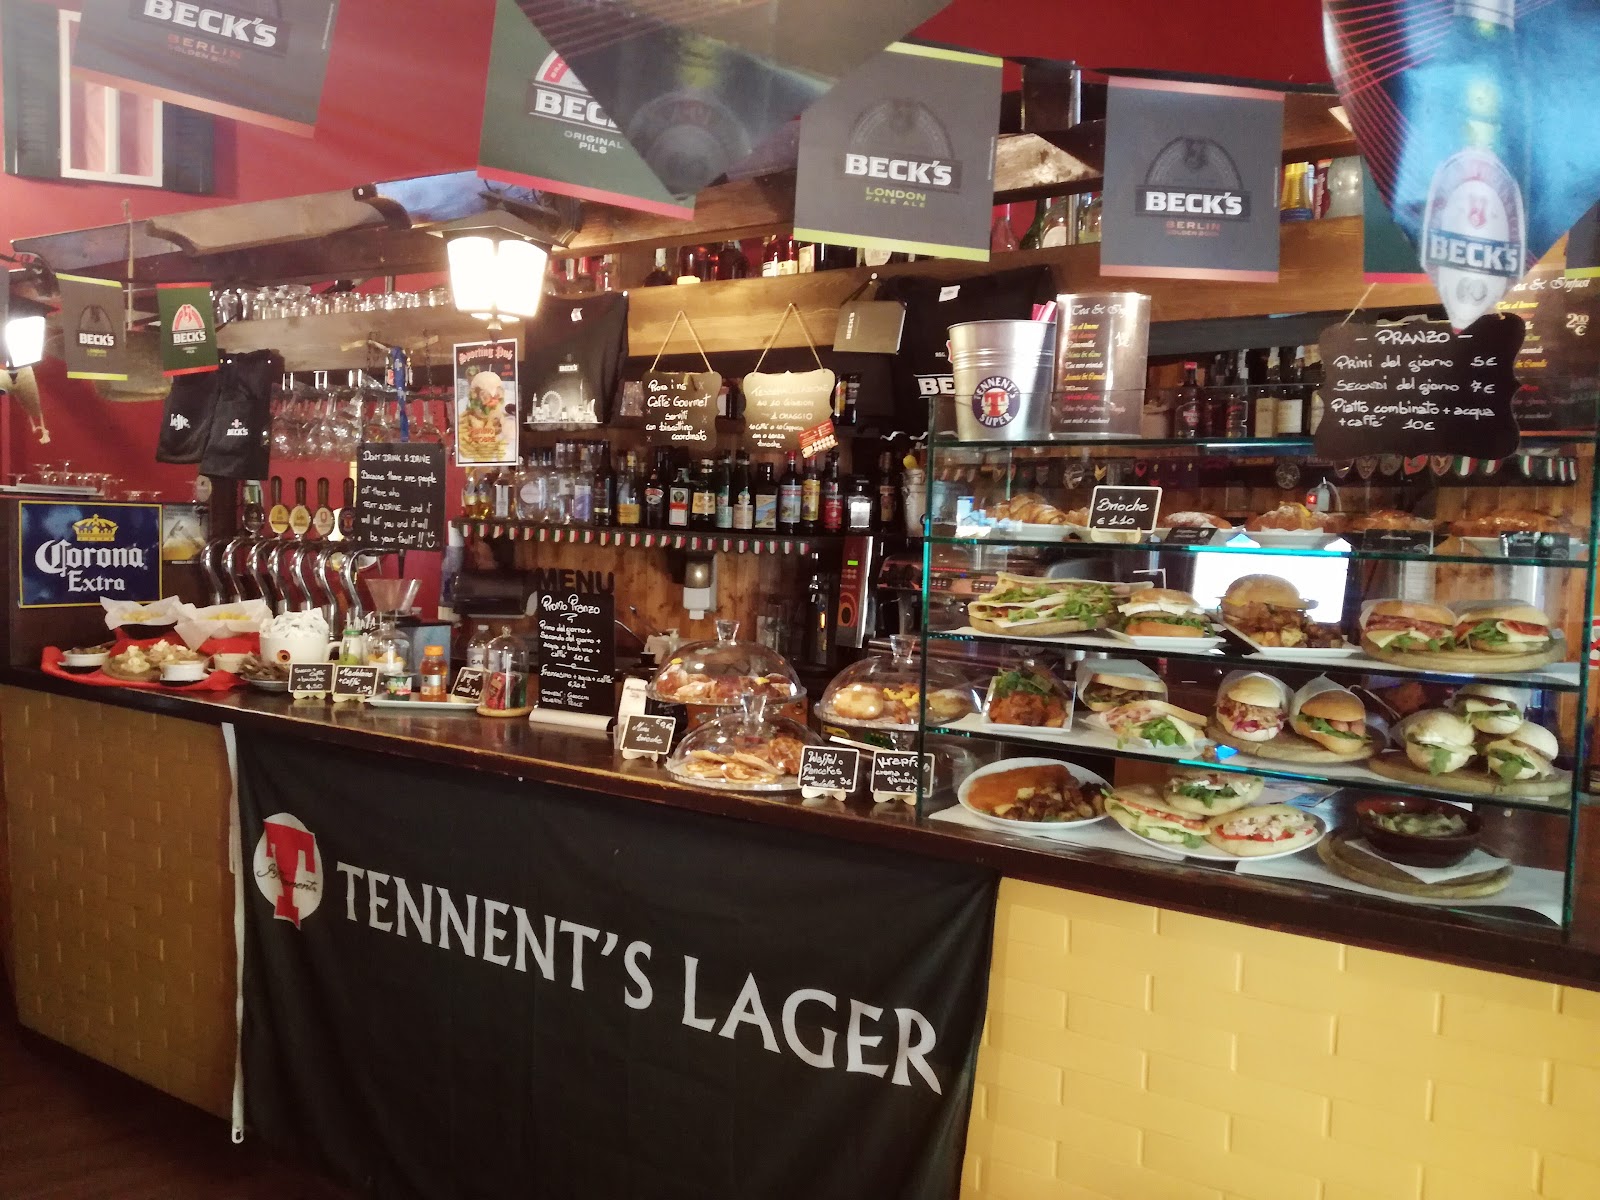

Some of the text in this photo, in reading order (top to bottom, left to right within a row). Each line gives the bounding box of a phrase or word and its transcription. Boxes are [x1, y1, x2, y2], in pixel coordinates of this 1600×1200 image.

[143, 0, 277, 48] BECK'S
[168, 33, 241, 60] BERLIN
[563, 130, 624, 149] ORIGINAL
[578, 141, 607, 155] PILS
[845, 153, 952, 187] BECK'S
[865, 187, 927, 202] LONDON
[1145, 191, 1243, 216] BECK'S
[1166, 221, 1221, 231] BERLIN
[1429, 234, 1519, 272] BECK'S
[845, 311, 856, 340] BECK'S
[79, 332, 115, 347] BECK'S
[173, 330, 207, 345] BECK'S
[1374, 329, 1451, 345] PRANZO
[1380, 354, 1401, 369] del
[1407, 354, 1454, 373] giorno
[973, 377, 1020, 400] TENNENT'S
[1396, 377, 1416, 391] del
[1418, 379, 1460, 396] giorno
[672, 392, 712, 408] Gourmet
[1331, 397, 1370, 413] Piatto
[1373, 400, 1440, 415] combinato
[1453, 406, 1496, 421] acqua
[979, 411, 1014, 427] SUPER
[671, 429, 708, 442] coordinato
[417, 471, 438, 488] people
[410, 502, 423, 514] and
[1096, 495, 1150, 512] Brioche
[1096, 517, 1105, 525] €
[34, 538, 145, 578] Corona
[67, 569, 126, 593] Extra
[534, 567, 615, 595] MENU
[541, 593, 601, 615] Promo Pranzo
[336, 860, 943, 1096] TENNENT'S LAGER
